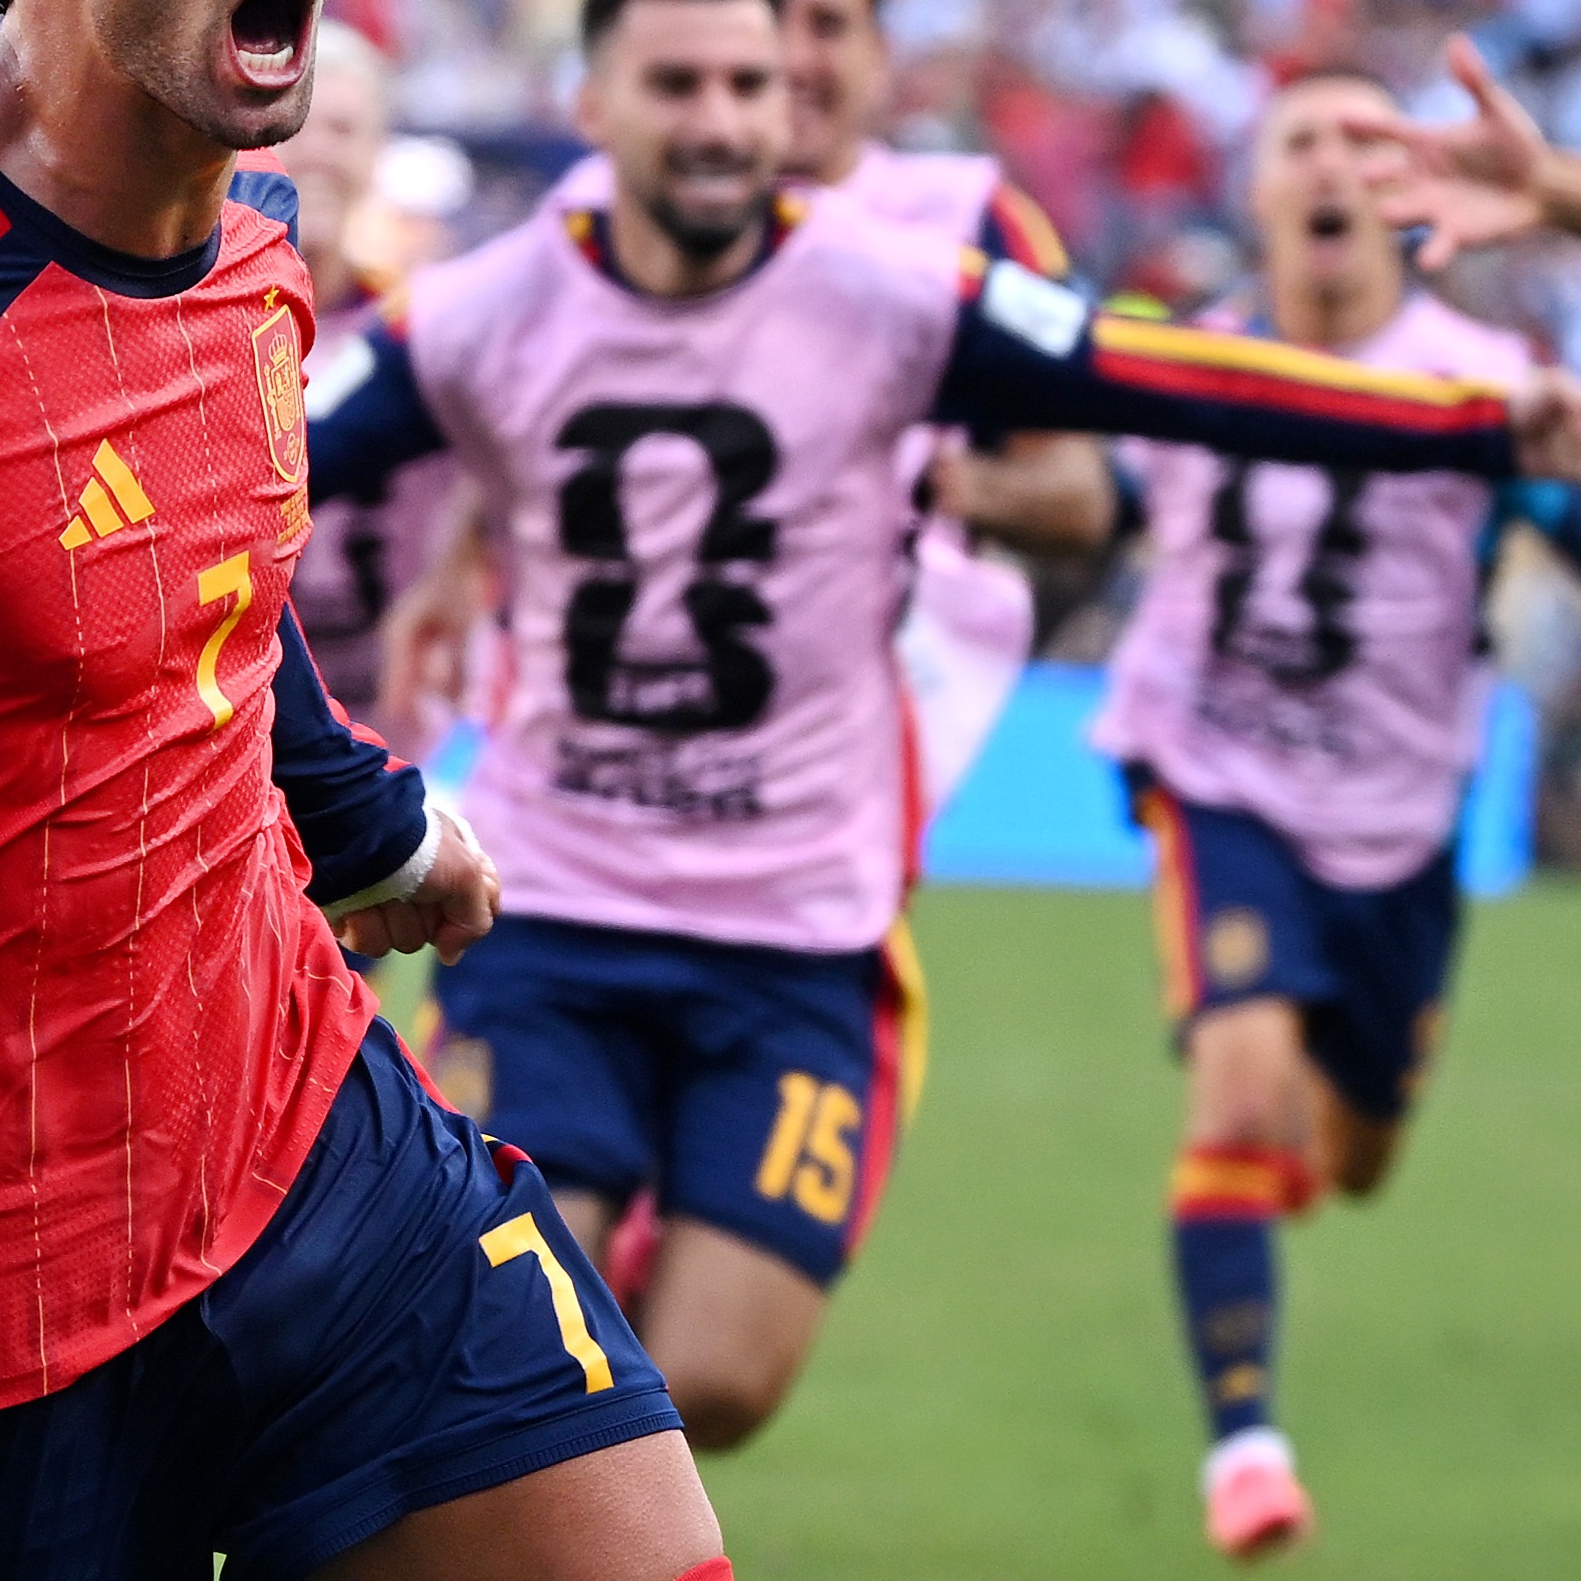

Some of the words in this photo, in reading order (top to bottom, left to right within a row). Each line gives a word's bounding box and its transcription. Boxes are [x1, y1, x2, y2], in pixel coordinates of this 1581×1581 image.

[197, 550, 252, 730] 7
[754, 1071, 861, 1226] 15
[478, 1211, 615, 1395] 7
